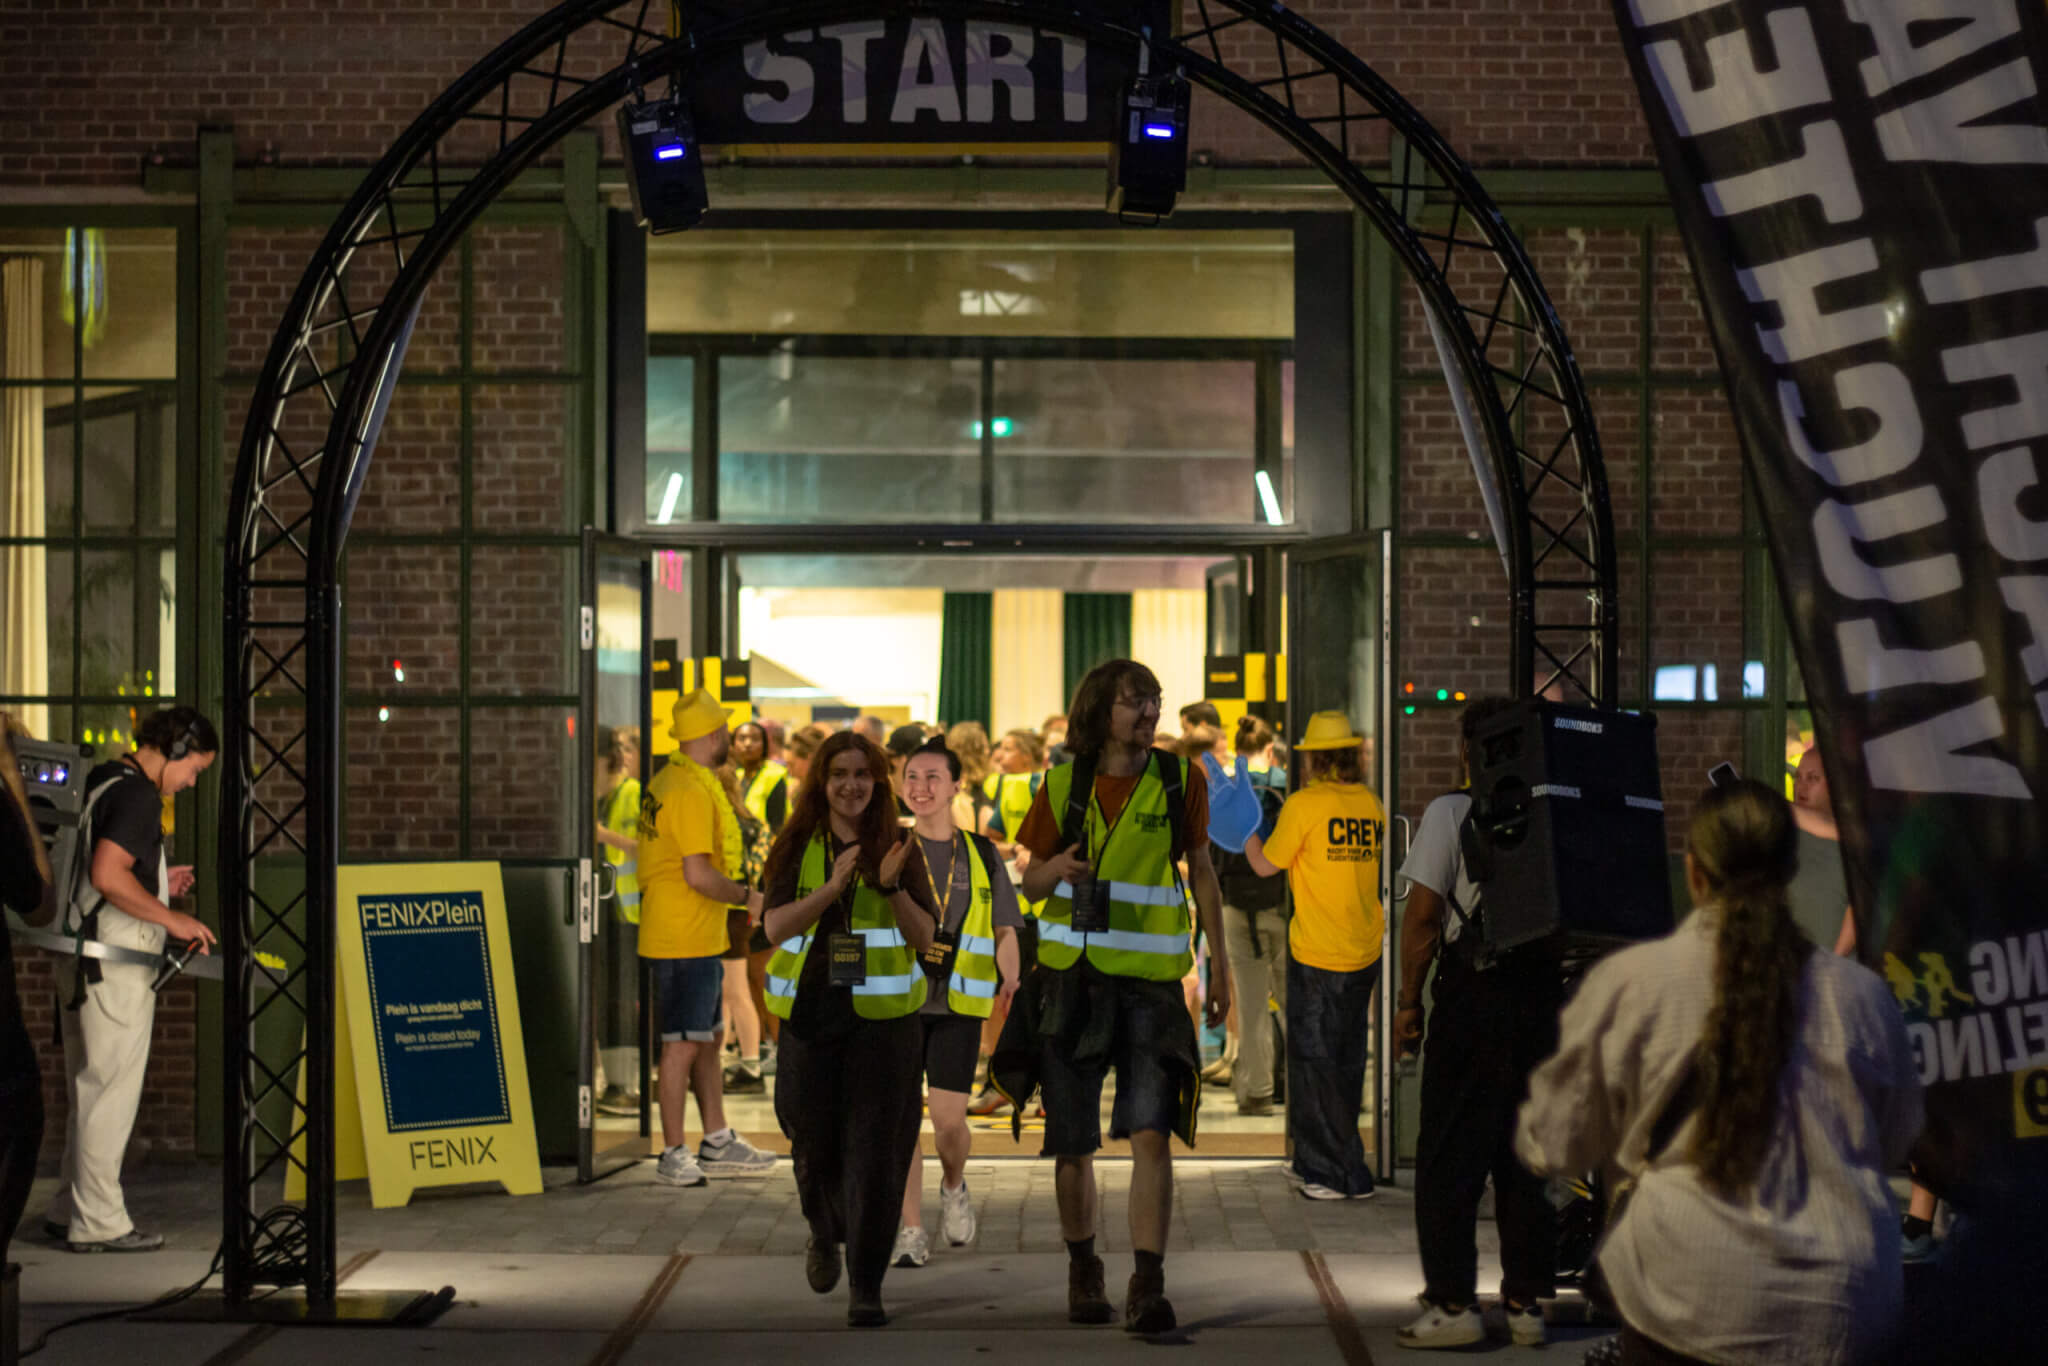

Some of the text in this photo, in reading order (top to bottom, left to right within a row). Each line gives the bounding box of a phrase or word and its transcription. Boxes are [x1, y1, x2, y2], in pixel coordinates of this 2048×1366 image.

[742, 16, 1089, 124] START
[361, 897, 484, 929] FENIXPlein
[408, 1135, 498, 1171] FENIX
